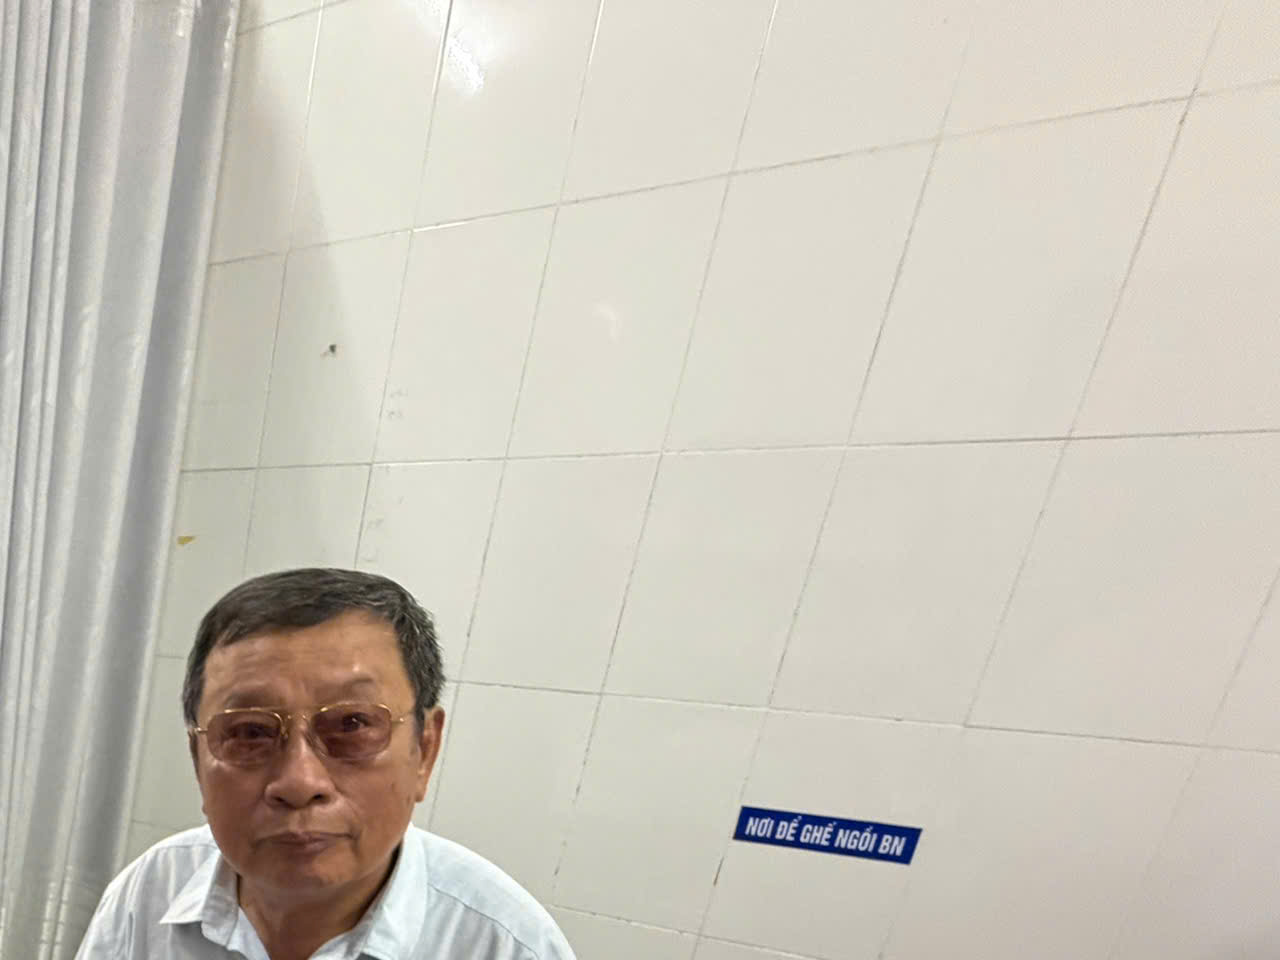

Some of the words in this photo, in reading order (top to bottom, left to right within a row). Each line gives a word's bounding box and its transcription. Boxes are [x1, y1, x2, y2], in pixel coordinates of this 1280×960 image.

[745, 817, 774, 838] NƠI
[800, 821, 837, 846] GHẾ
[878, 834, 907, 857] BN
